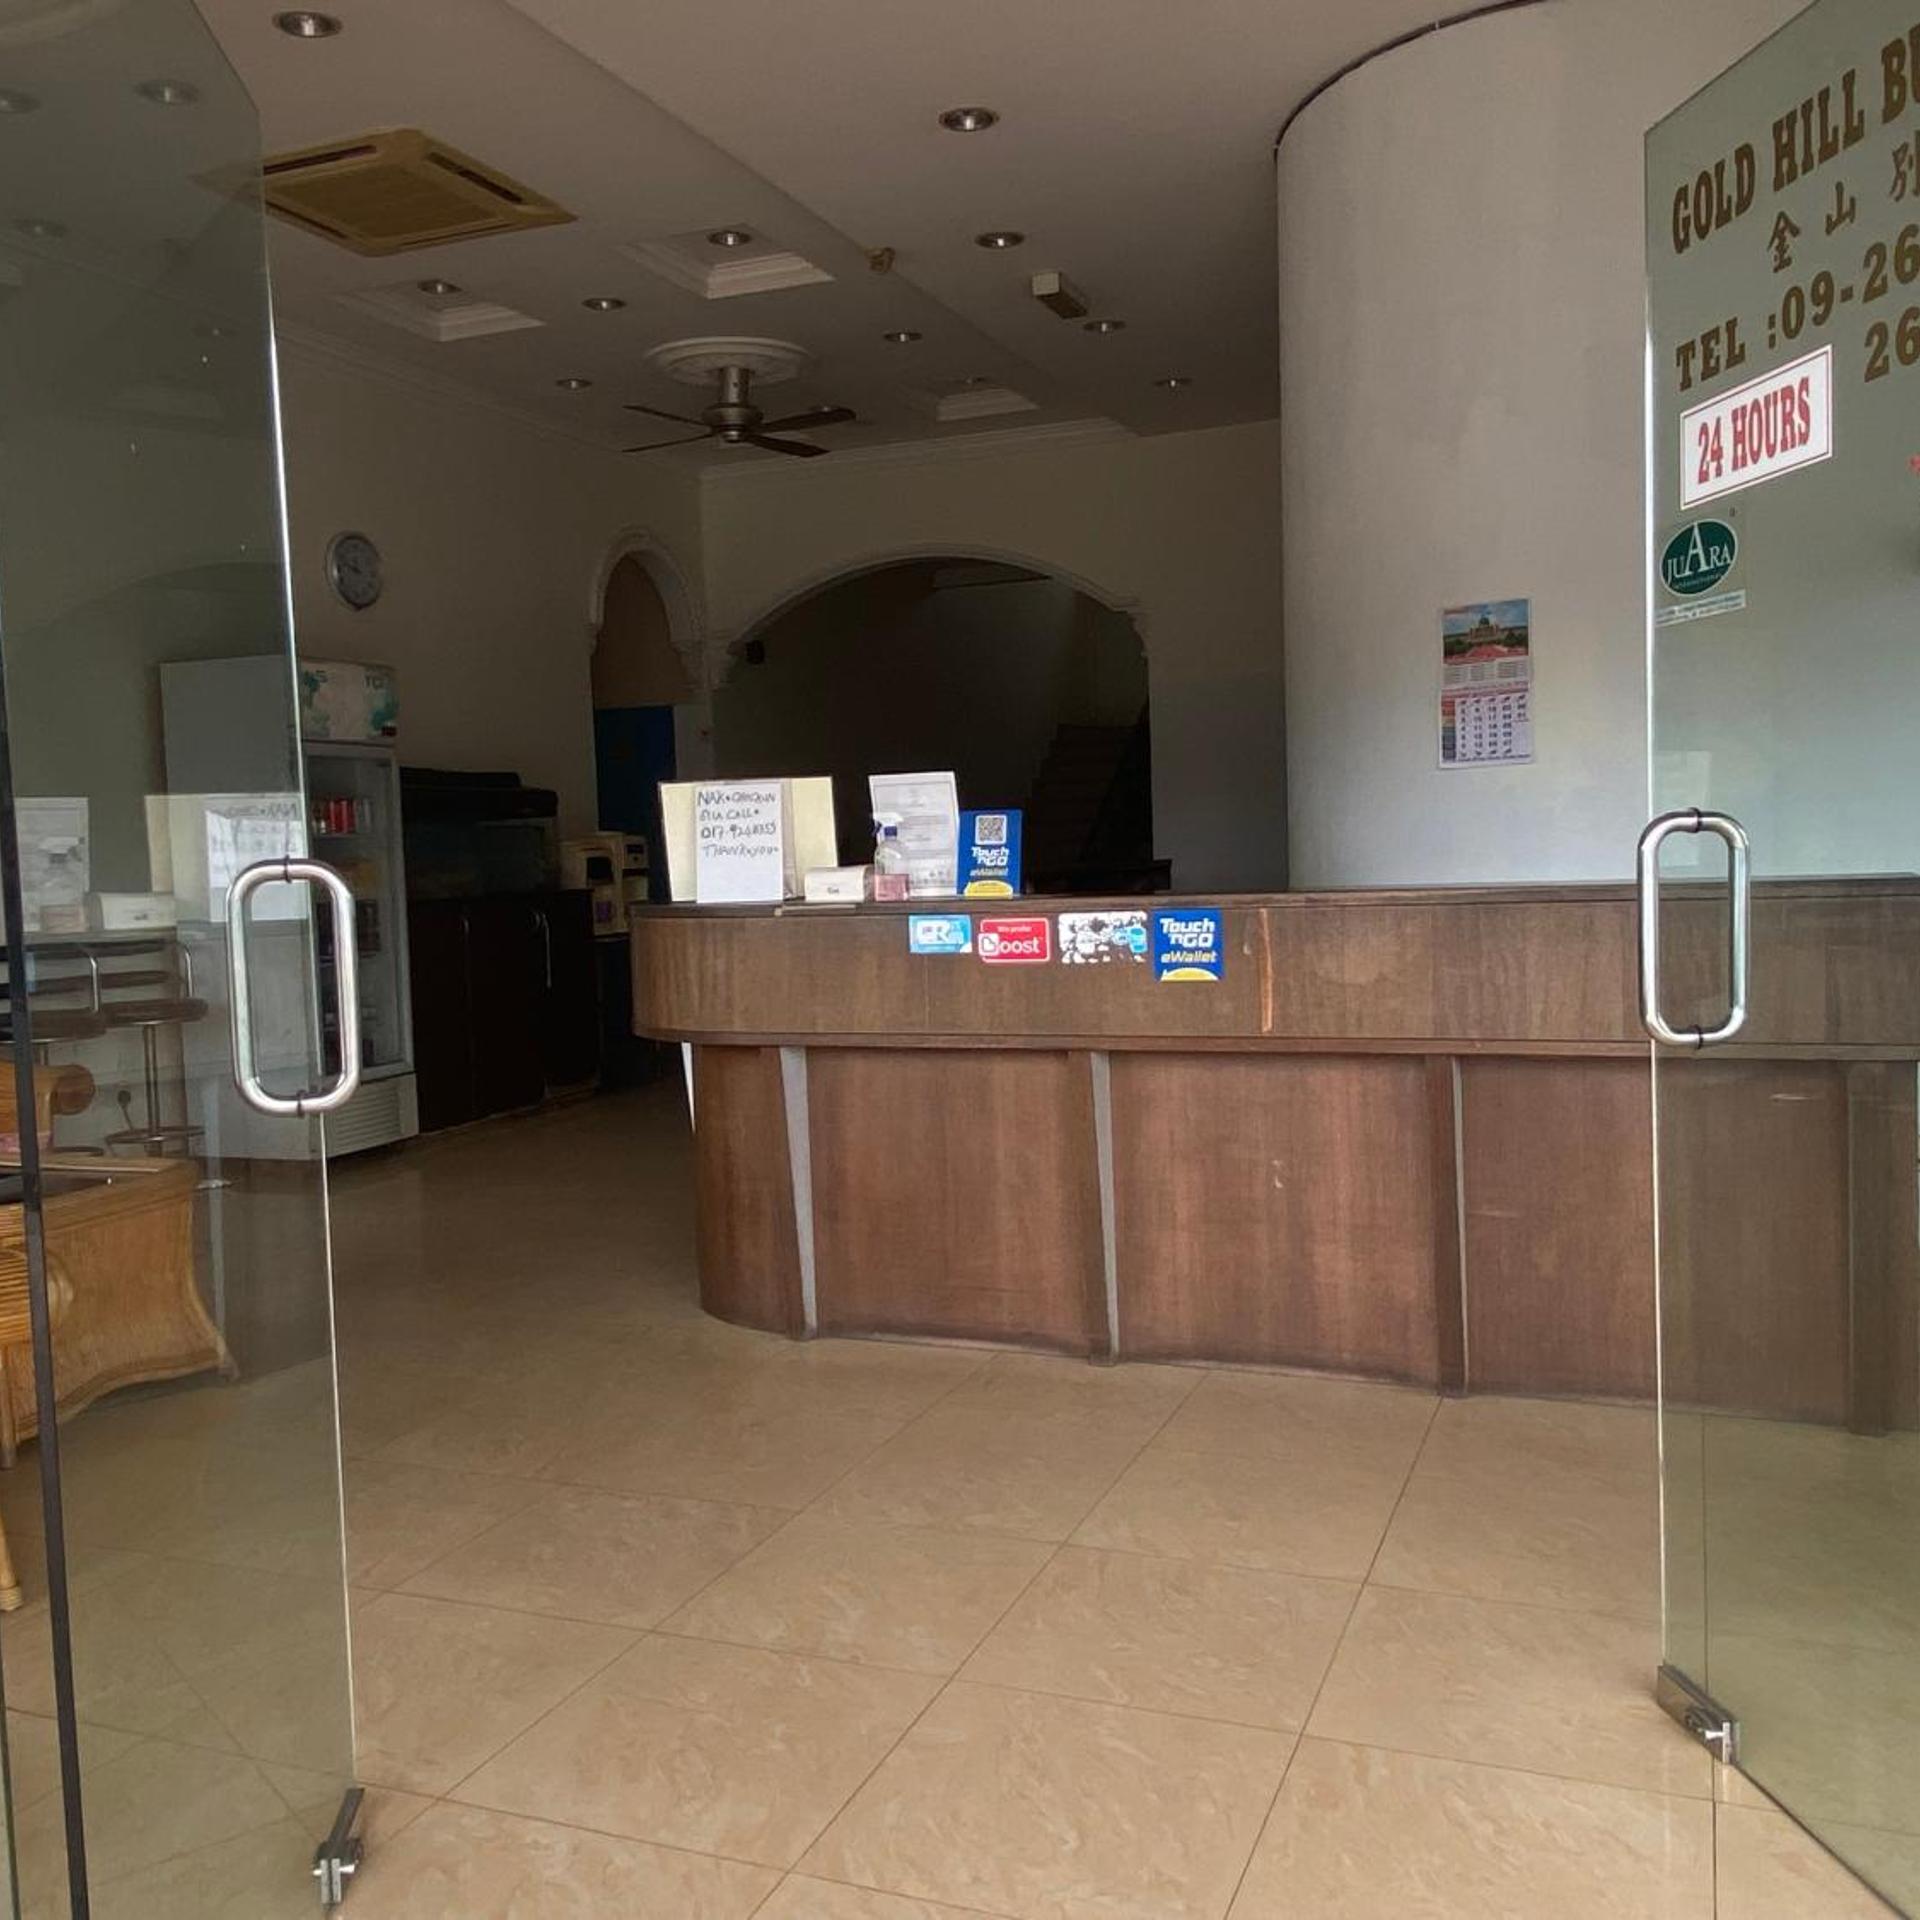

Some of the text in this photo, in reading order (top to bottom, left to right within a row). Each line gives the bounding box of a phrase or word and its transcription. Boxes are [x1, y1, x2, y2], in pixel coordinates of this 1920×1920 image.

[1672, 143, 1756, 254] GOLD
[1772, 68, 1865, 192] HILL
[1676, 317, 1746, 392] TEL
[1864, 306, 1920, 383] 26
[1698, 376, 1811, 484] 24 HOURS
[1159, 917, 1215, 933] Touch
[1161, 950, 1218, 963] eWallet
